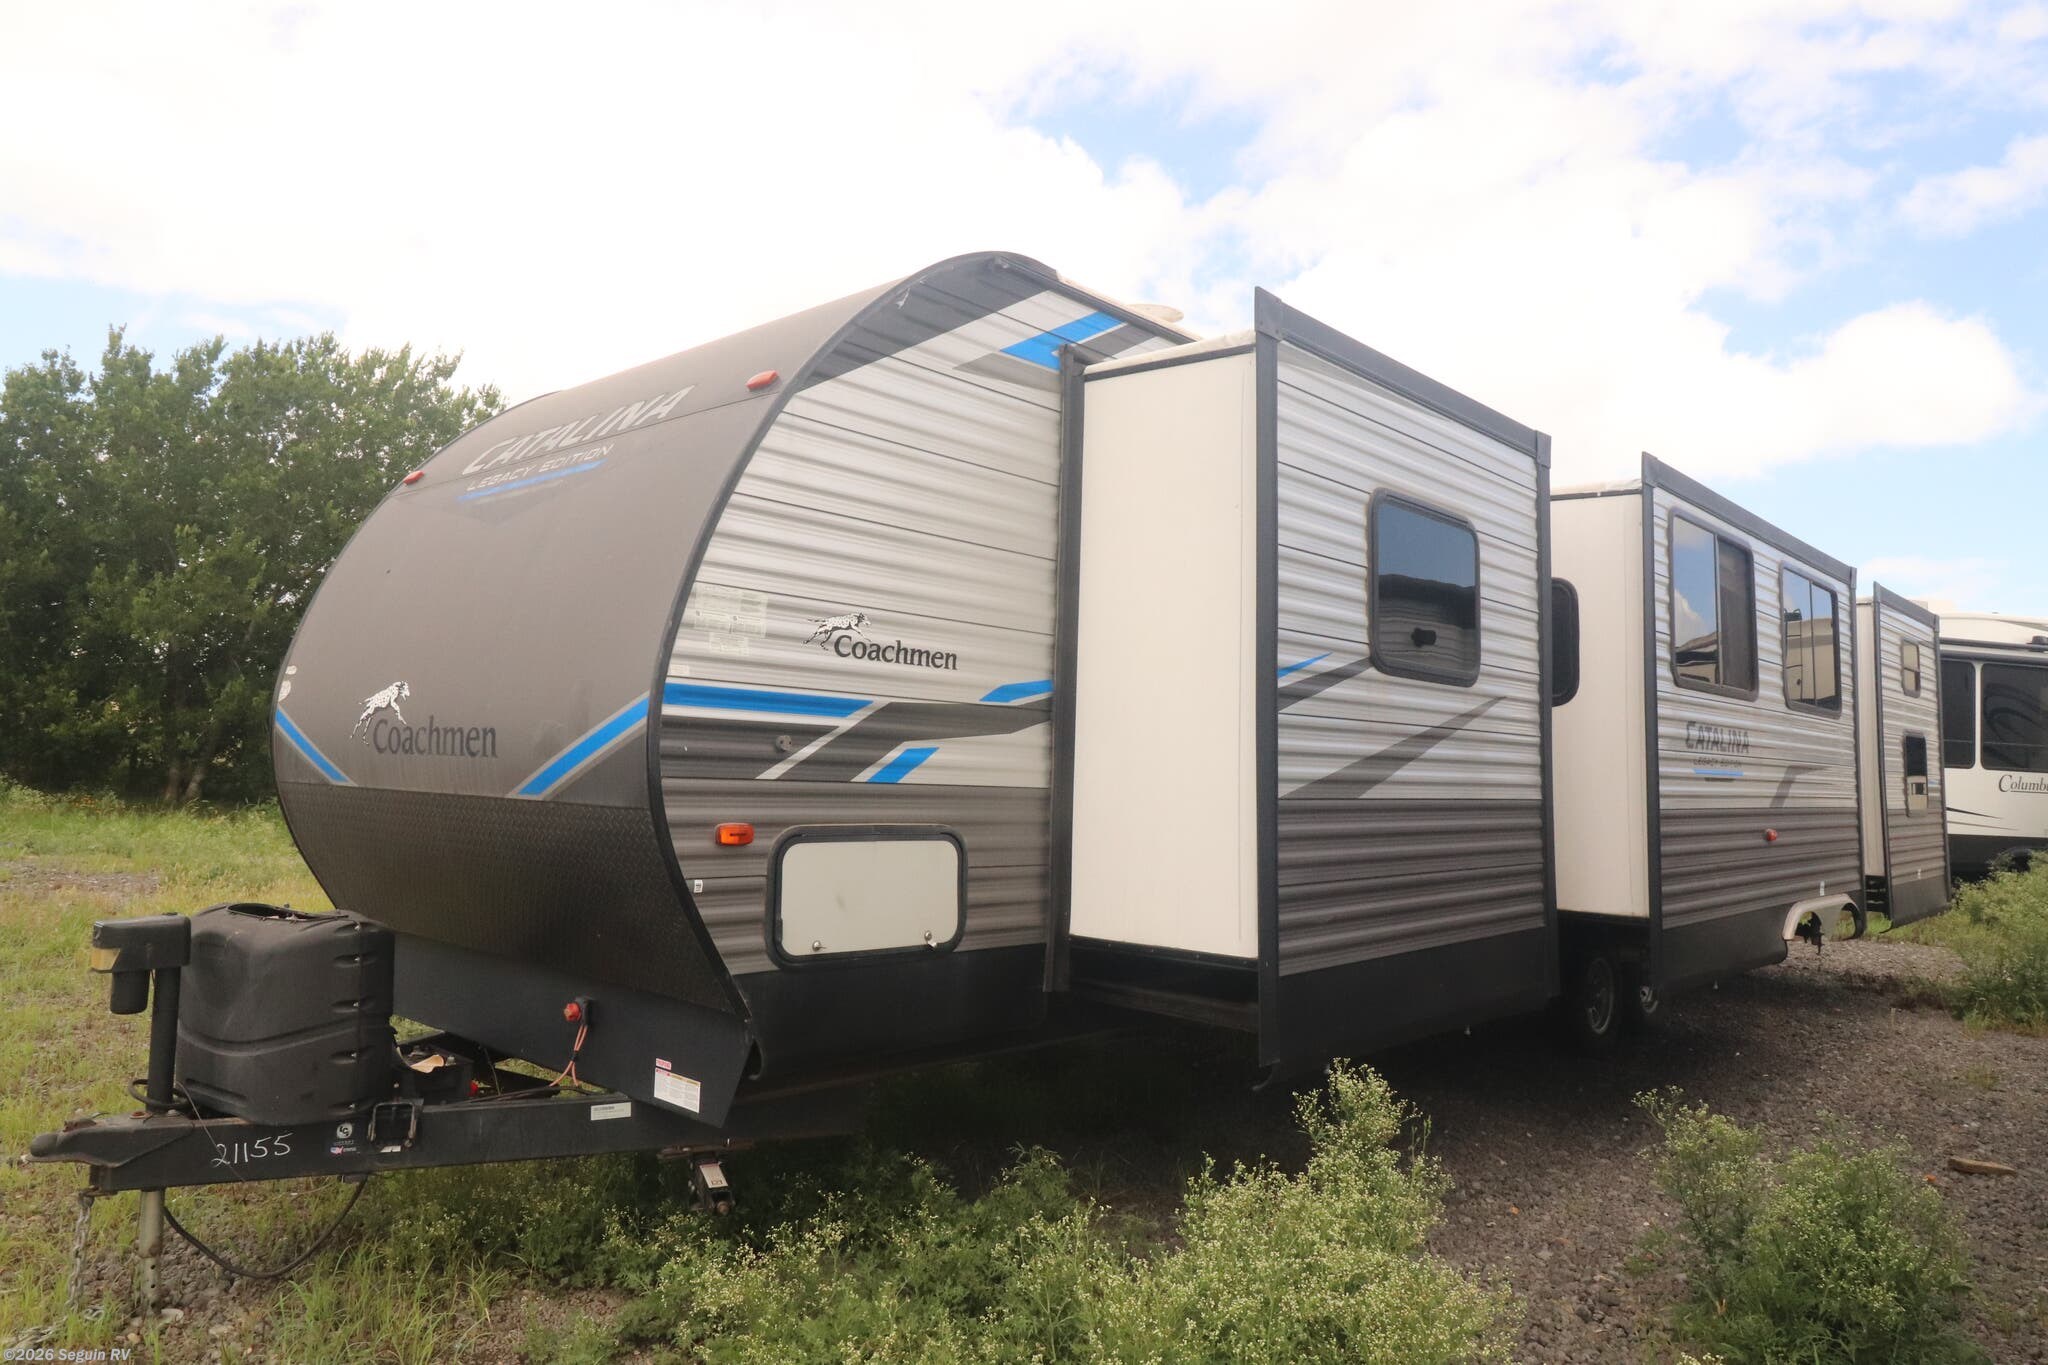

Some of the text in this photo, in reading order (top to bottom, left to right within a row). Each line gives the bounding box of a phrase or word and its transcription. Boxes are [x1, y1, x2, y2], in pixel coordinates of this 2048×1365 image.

[462, 385, 695, 475] CATALINA
[466, 444, 614, 491] LEGACY EDITION
[834, 635, 958, 671] Coachmen
[373, 715, 498, 758] Coachmen
[1685, 721, 1749, 753] CATALINA
[1998, 774, 2048, 792] Columb
[210, 1132, 294, 1167] 21155
